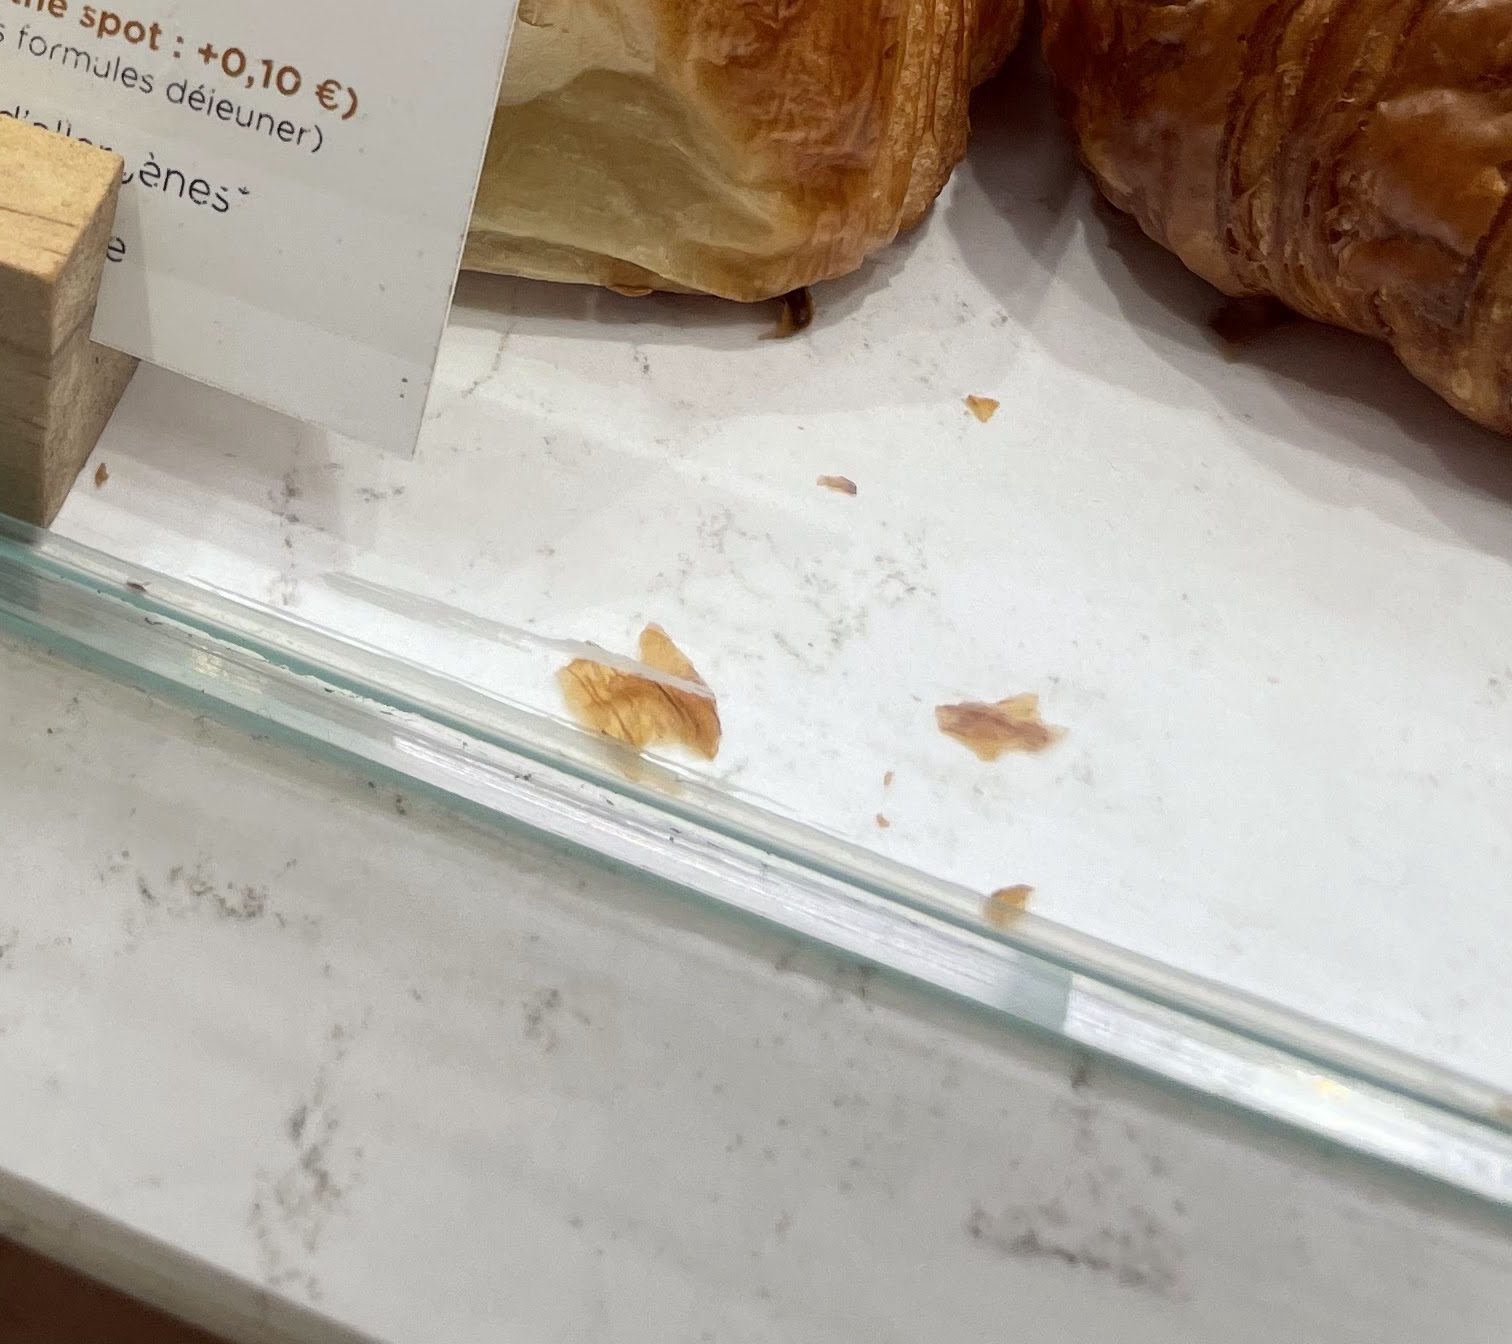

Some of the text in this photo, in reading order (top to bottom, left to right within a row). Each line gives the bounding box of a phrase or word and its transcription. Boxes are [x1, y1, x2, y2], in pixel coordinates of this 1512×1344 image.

[18, 24, 154, 95] formules
[79, 4, 162, 52] spot
[198, 43, 301, 97] +0,10
[315, 79, 359, 120] €)
